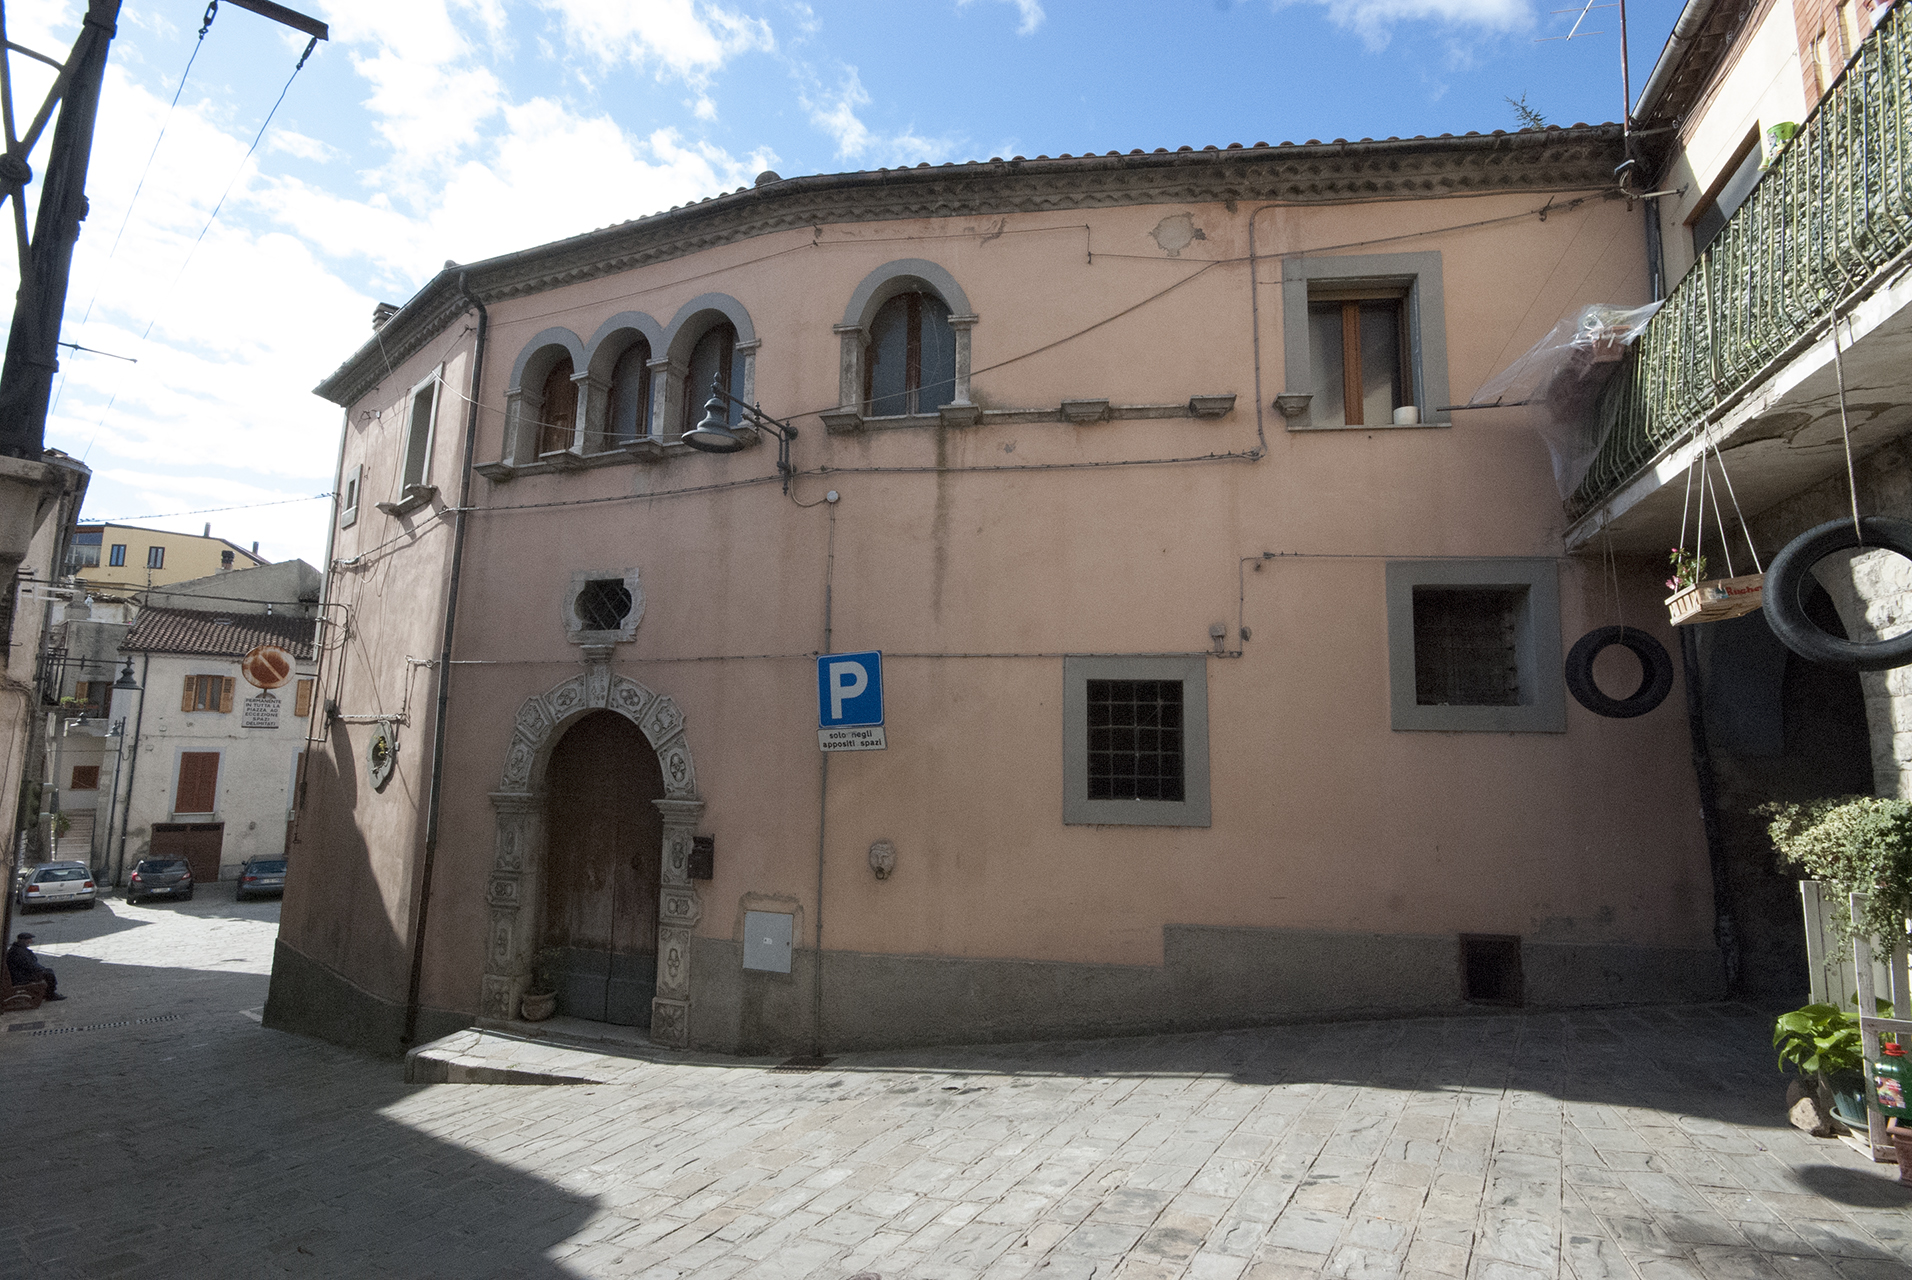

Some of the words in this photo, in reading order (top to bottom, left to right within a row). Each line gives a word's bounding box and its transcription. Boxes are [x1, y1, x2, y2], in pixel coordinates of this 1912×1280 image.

[829, 661, 868, 719] P
[829, 731, 846, 739] solo
[851, 730, 872, 739] negli
[822, 740, 856, 749] appositi
[860, 738, 882, 747] spazi
